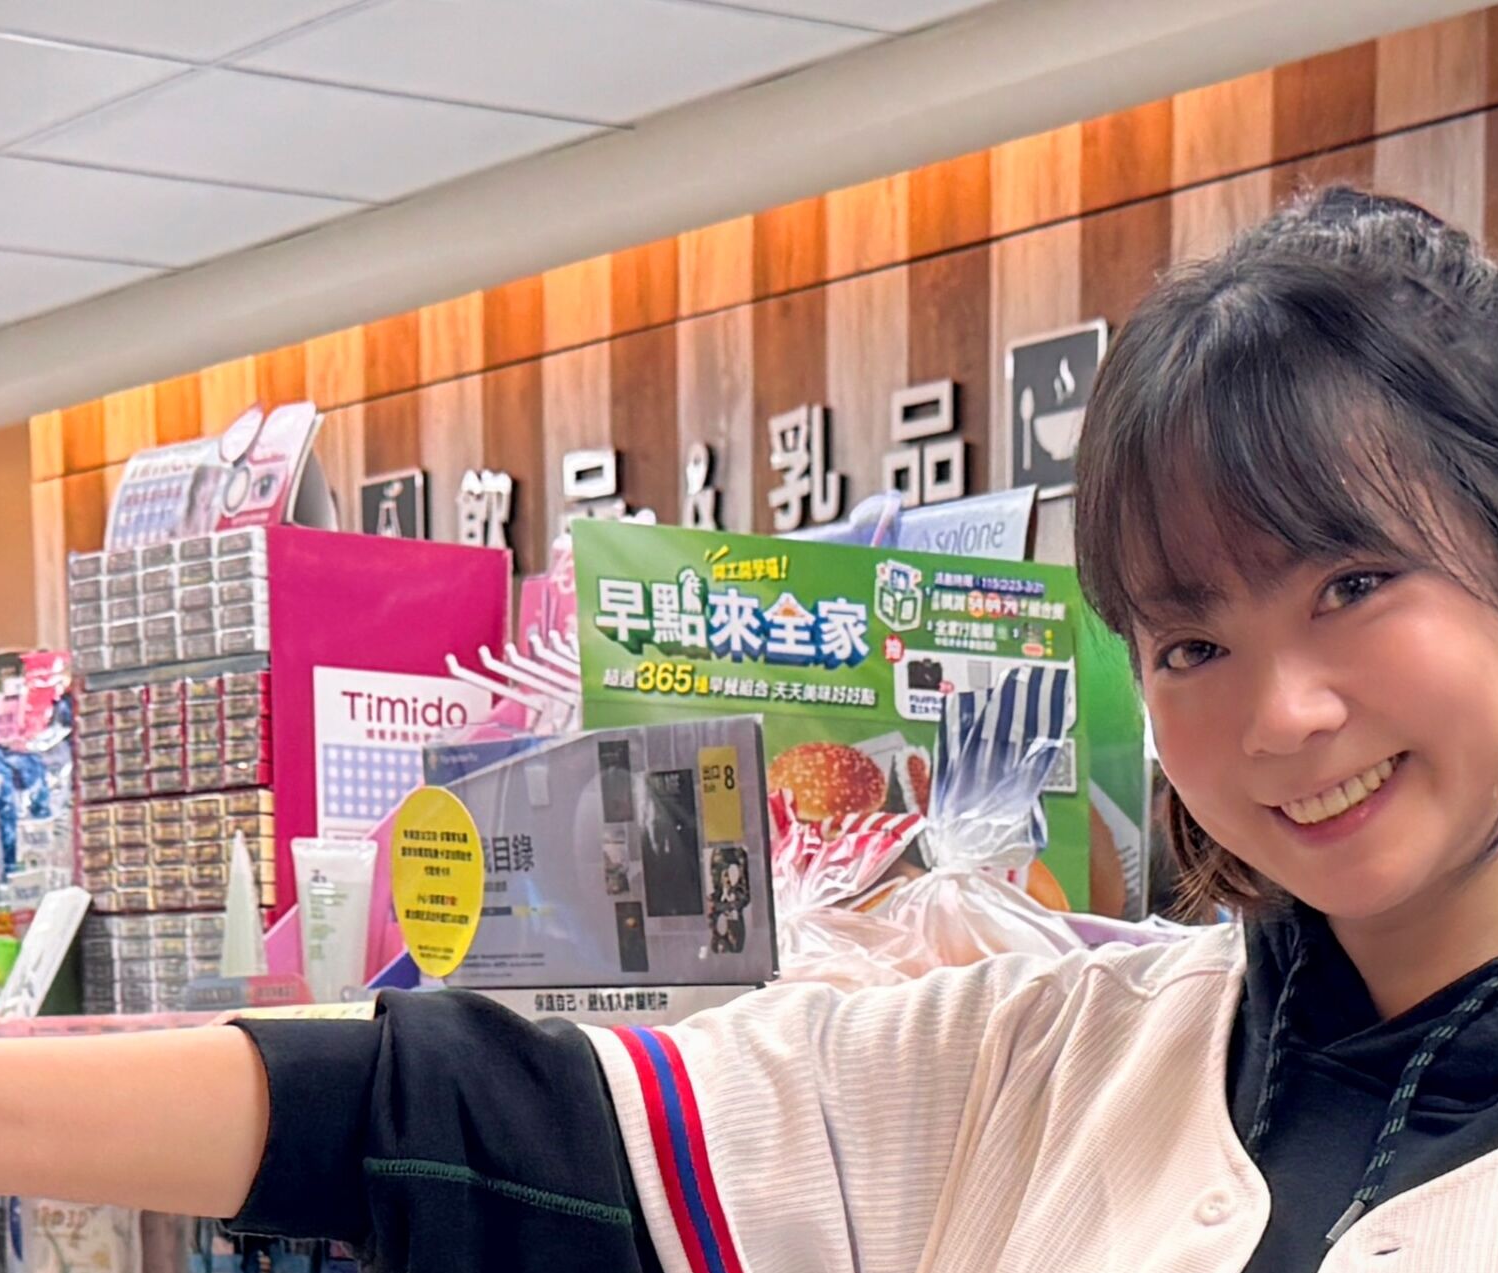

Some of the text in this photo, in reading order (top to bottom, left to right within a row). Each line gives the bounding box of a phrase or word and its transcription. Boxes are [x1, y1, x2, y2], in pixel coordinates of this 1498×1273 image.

[767, 379, 967, 531] 乳品
[595, 578, 871, 662] 早點來全家
[340, 690, 468, 729] Timido
[723, 764, 736, 790] 8
